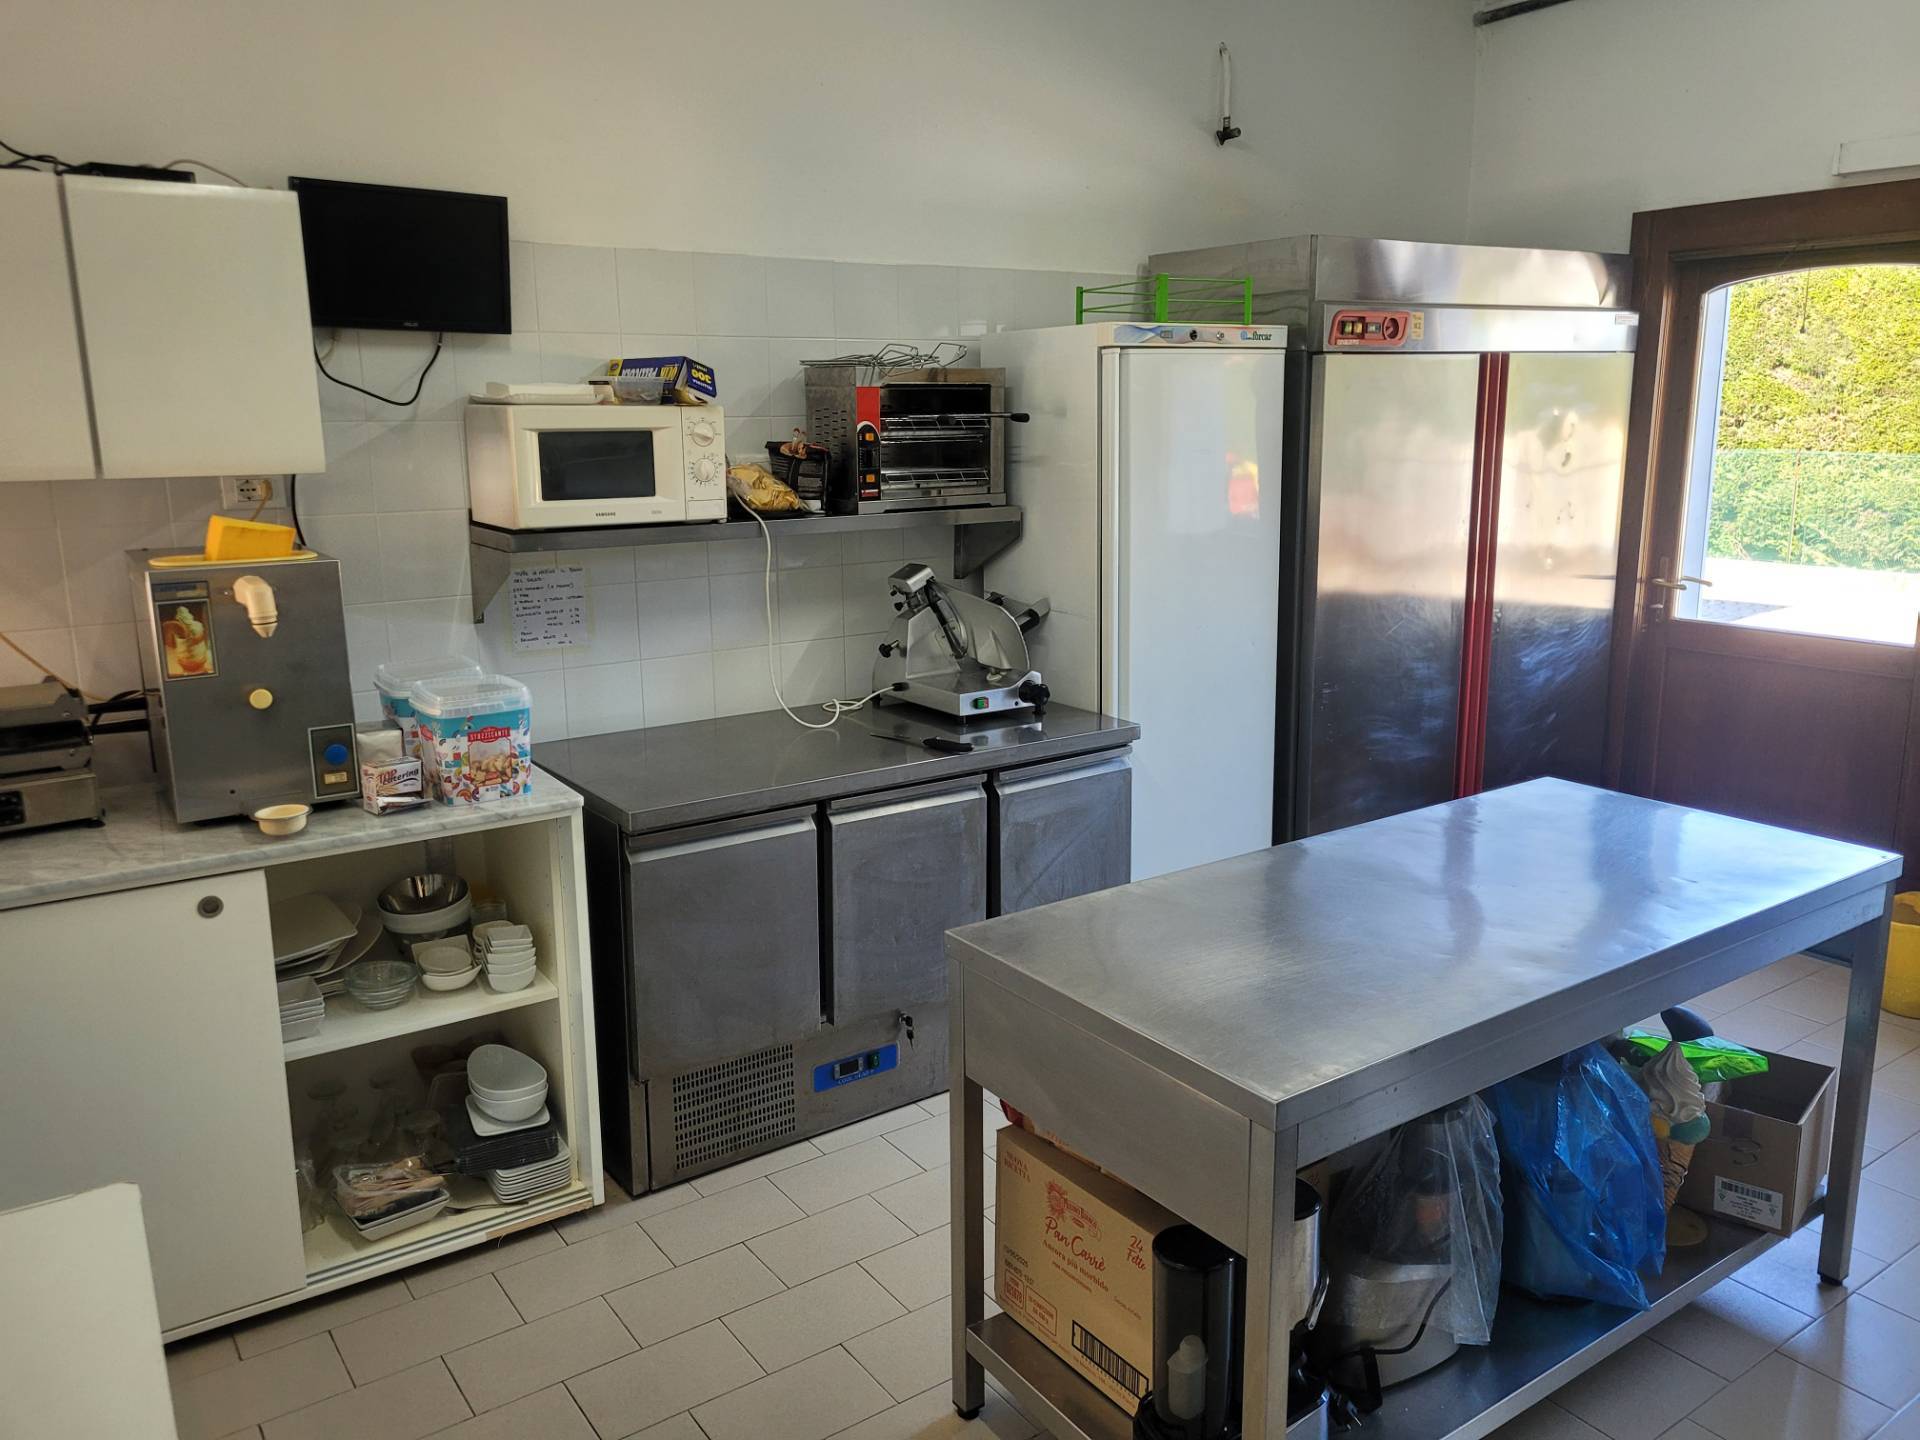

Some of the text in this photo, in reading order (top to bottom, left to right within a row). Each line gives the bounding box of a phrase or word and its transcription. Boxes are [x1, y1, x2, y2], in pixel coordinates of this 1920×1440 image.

[1045, 1216, 1071, 1247] Pan
[1071, 1236, 1106, 1272] Carrè
[1129, 1235, 1144, 1253] 24
